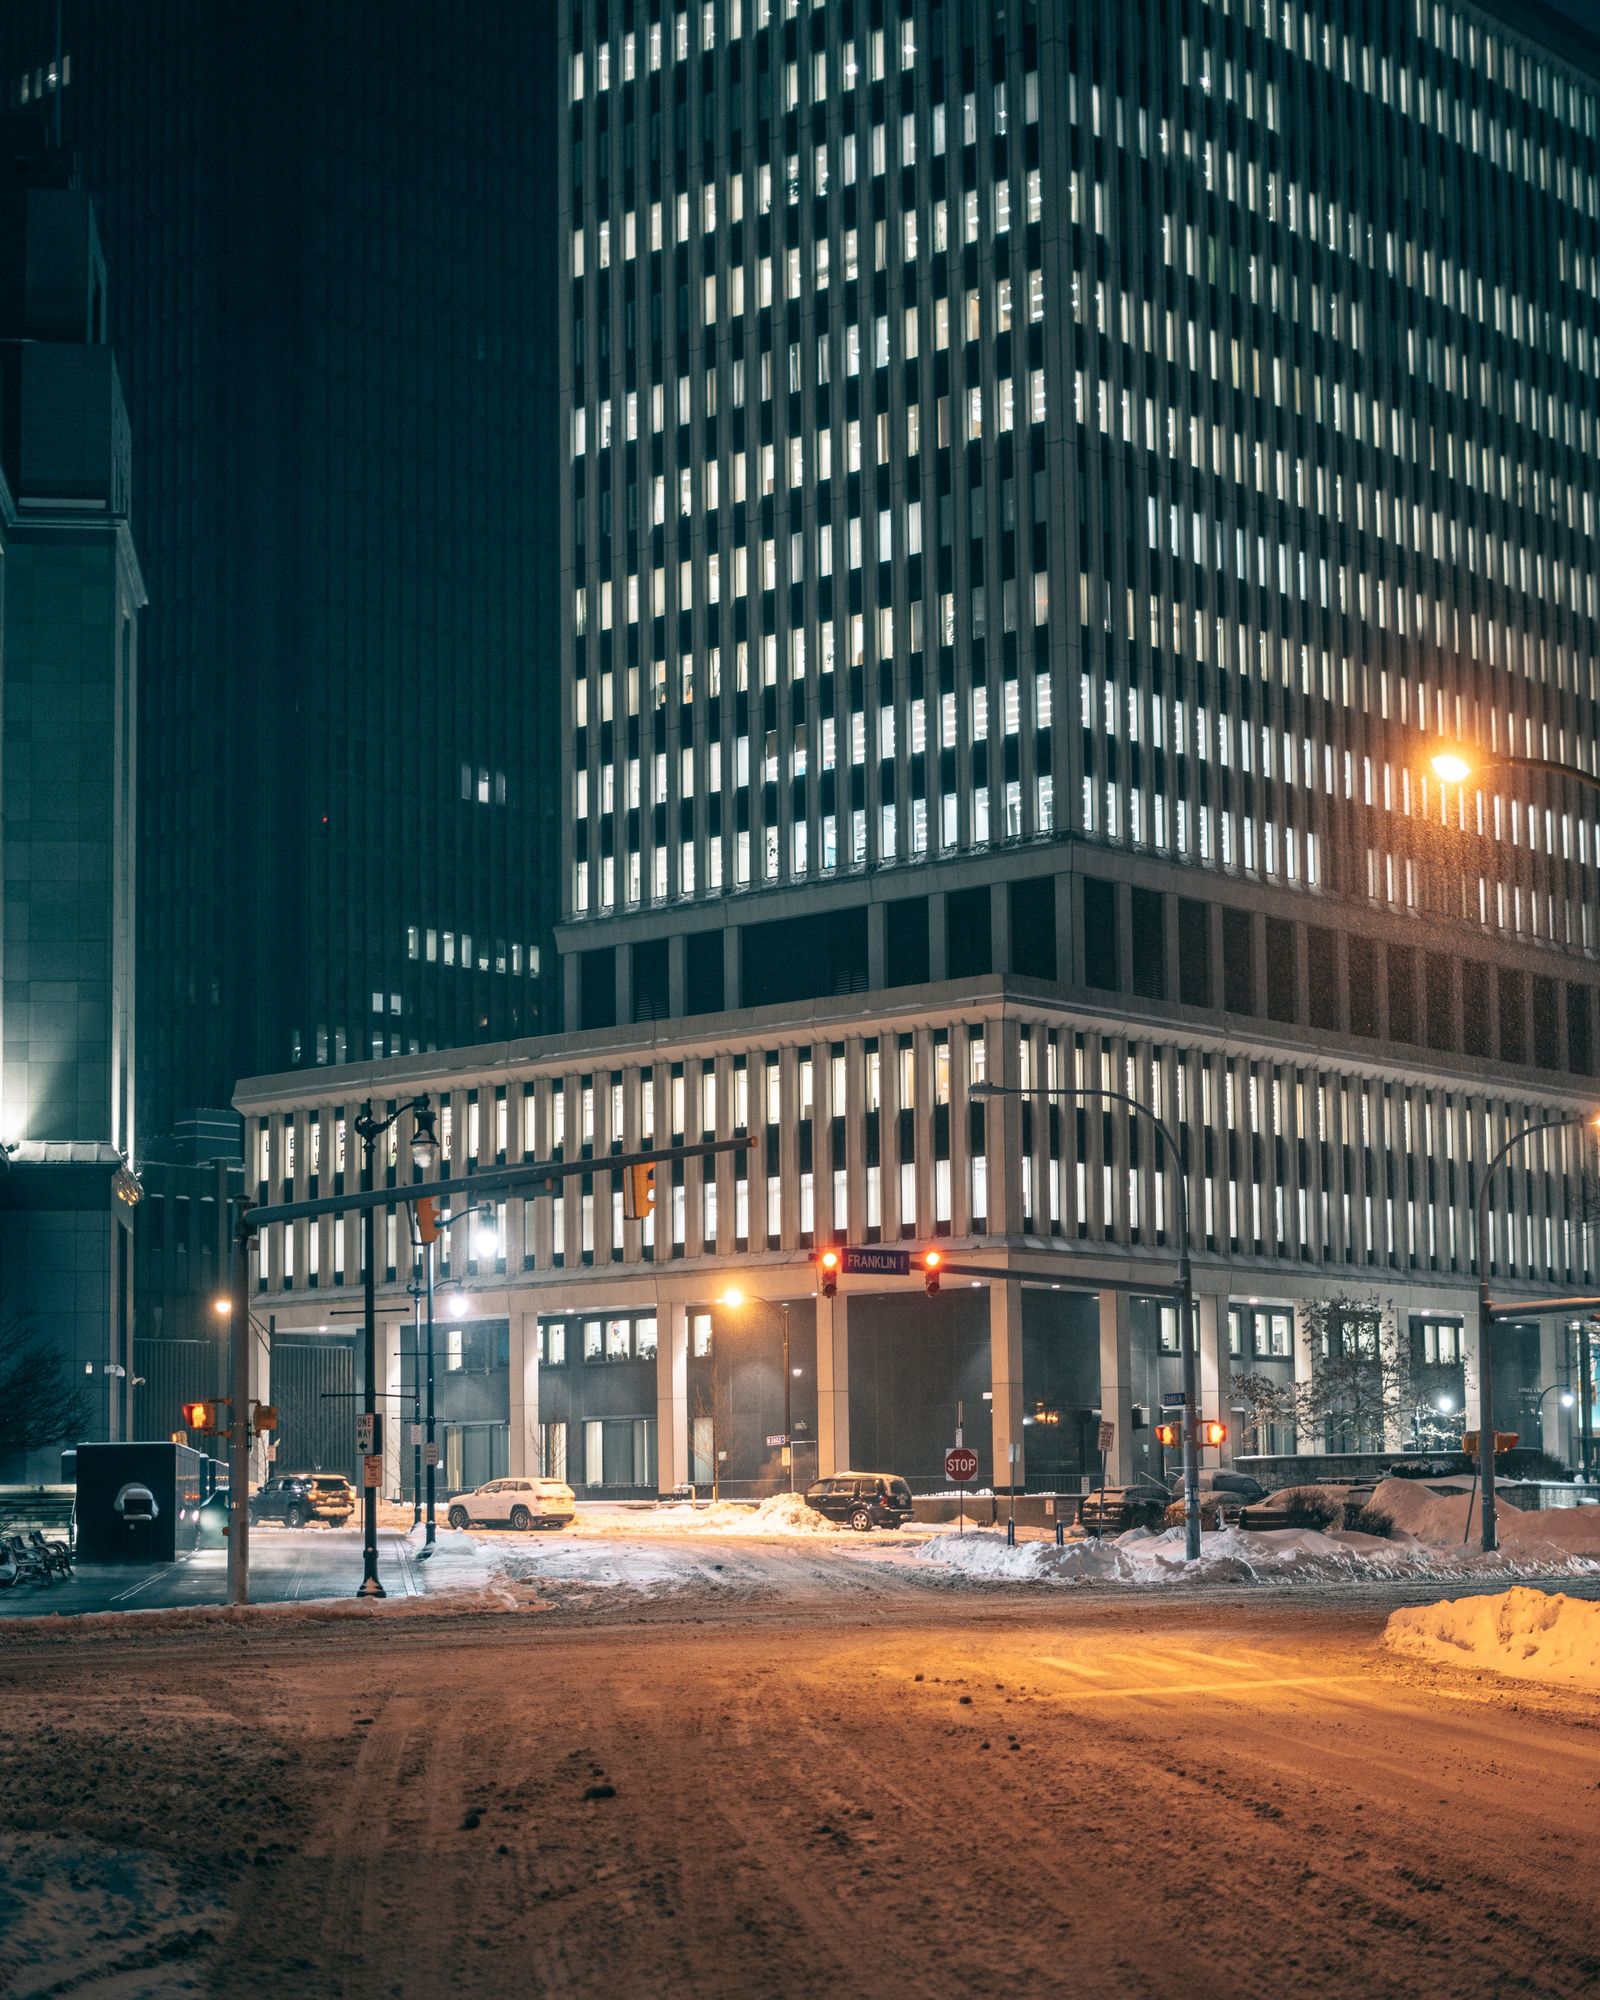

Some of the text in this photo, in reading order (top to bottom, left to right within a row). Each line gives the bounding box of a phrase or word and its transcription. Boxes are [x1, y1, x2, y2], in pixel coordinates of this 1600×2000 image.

[848, 1255, 897, 1269] FRANKLIN
[357, 1416, 373, 1428] ONE
[357, 1429, 373, 1439] WAY
[947, 1458, 976, 1472] STOP
